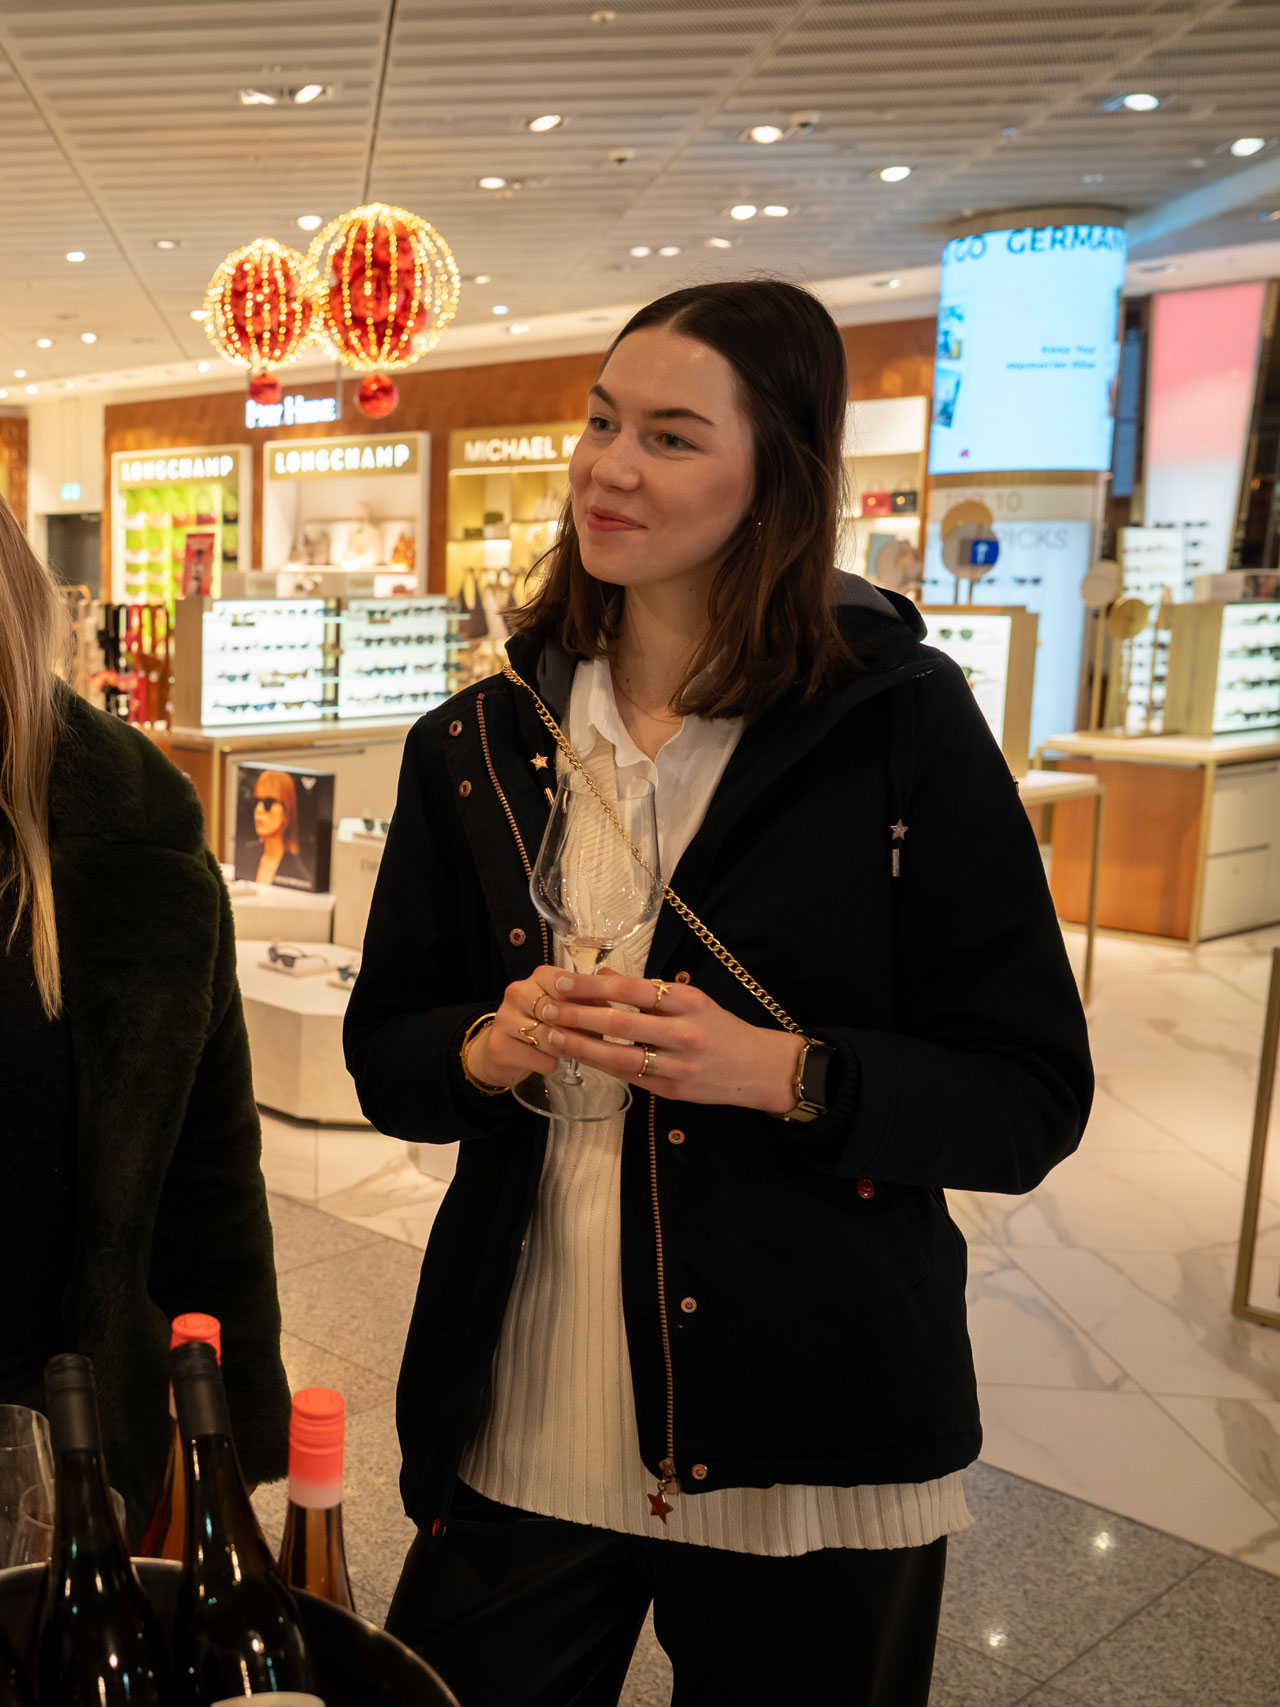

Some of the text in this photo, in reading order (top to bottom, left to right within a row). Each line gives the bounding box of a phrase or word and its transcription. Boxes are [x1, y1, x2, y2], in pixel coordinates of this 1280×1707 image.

[274, 444, 410, 474] LONGCHAMP
[464, 435, 557, 462] MICHAEL
[121, 455, 234, 482] LONGCHAMP
